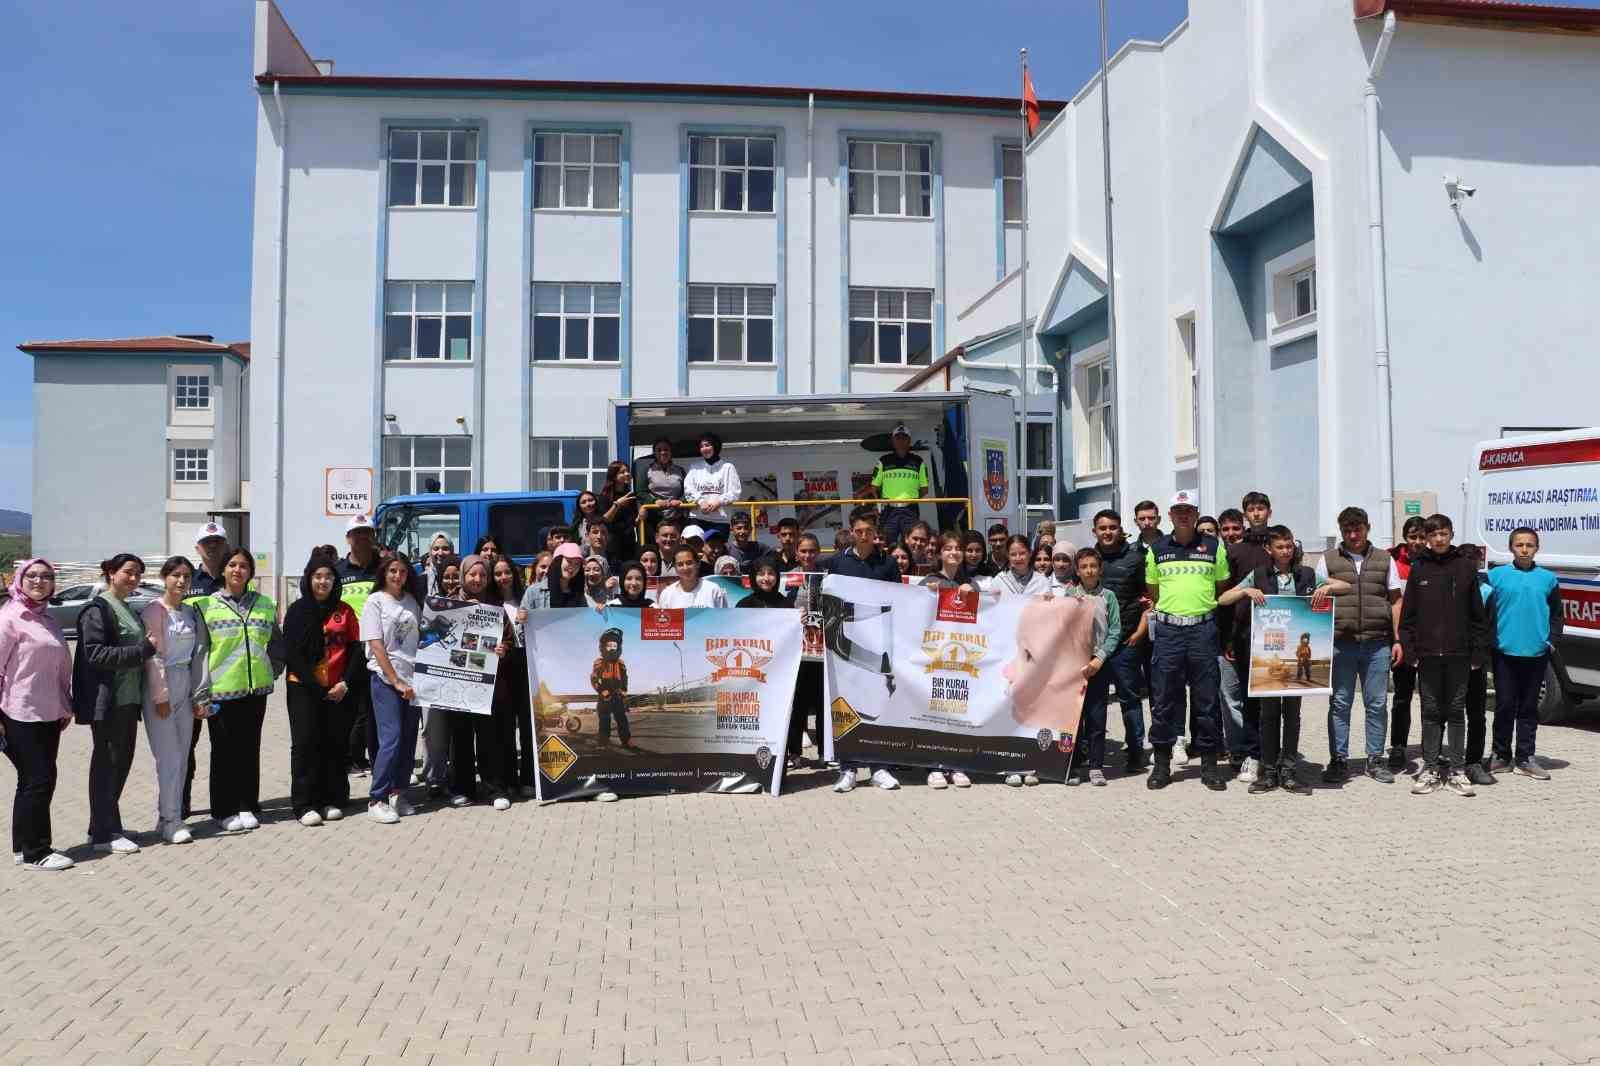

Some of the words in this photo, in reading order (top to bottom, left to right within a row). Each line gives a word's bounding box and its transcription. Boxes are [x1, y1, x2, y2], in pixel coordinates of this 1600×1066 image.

[1482, 452, 1524, 465] J-KARACA
[1488, 489, 1514, 505] TRAFİK
[1515, 490, 1545, 504] KAZASI
[1546, 488, 1598, 506] ARAŞTIRMA
[1484, 518, 1494, 531] VE
[1495, 518, 1515, 531] KAZA
[945, 678, 969, 690] KURAL
